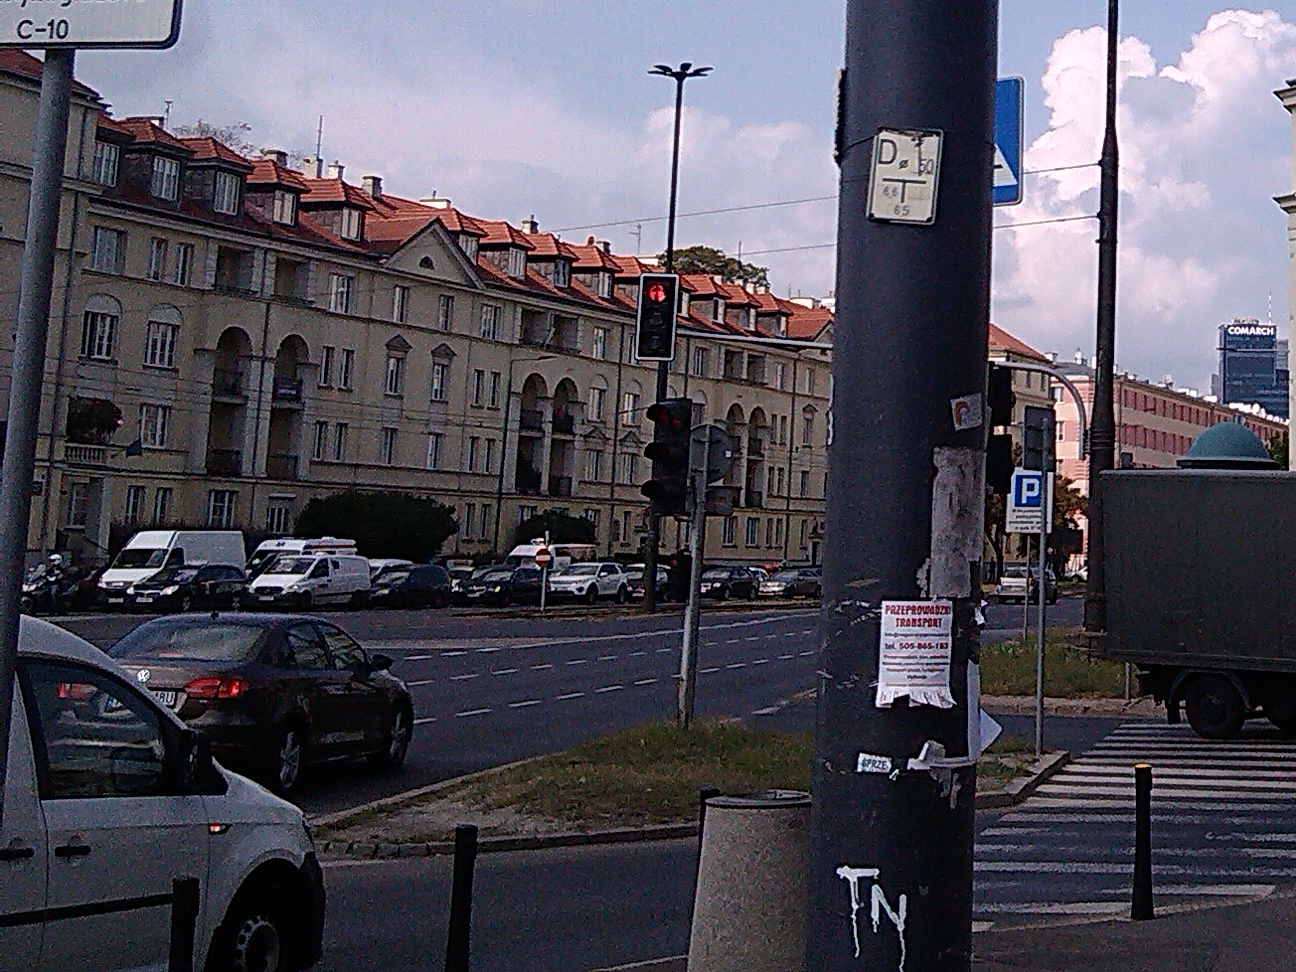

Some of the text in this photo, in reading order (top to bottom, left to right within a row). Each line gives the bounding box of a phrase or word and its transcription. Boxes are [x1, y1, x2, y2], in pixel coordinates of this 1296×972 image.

[16, 19, 69, 40] C-10
[878, 138, 898, 165] D
[1227, 326, 1275, 336] COMARCH
[1021, 478, 1041, 504] P
[895, 618, 943, 628] TRANSPORT
